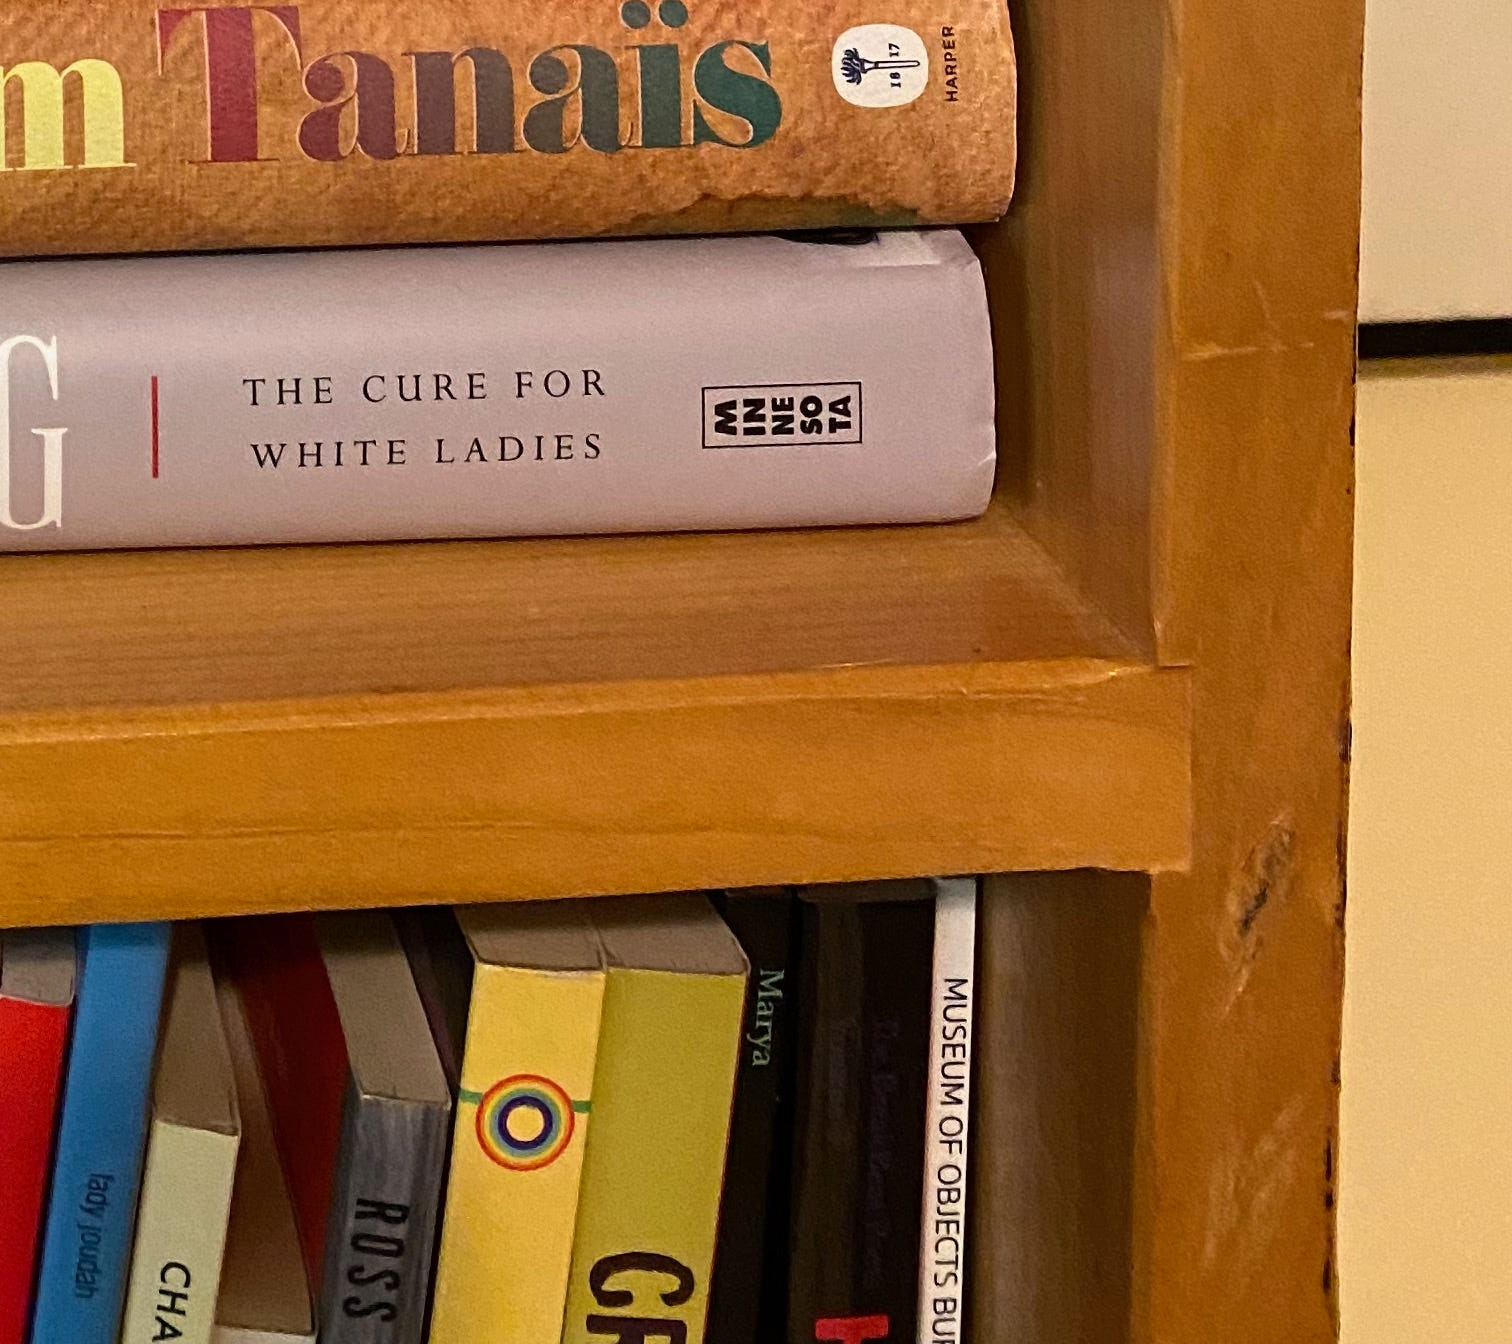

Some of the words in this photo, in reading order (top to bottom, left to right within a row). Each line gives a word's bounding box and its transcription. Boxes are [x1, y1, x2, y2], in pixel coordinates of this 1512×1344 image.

[942, 26, 959, 102] HARPER
[242, 376, 333, 407] THE
[363, 372, 487, 403] CURE
[515, 368, 606, 399] FOR
[251, 439, 407, 470] WHITE
[435, 433, 602, 465] LADIES
[747, 966, 785, 1067] Marya
[940, 978, 968, 1106] MUSEUM
[938, 1115, 964, 1156] OF
[78, 1173, 115, 1221] fady
[933, 1164, 962, 1288] OBJECTS
[74, 1223, 102, 1299] joudah
[343, 1198, 409, 1323] ROSS
[931, 1296, 958, 1344] BU
